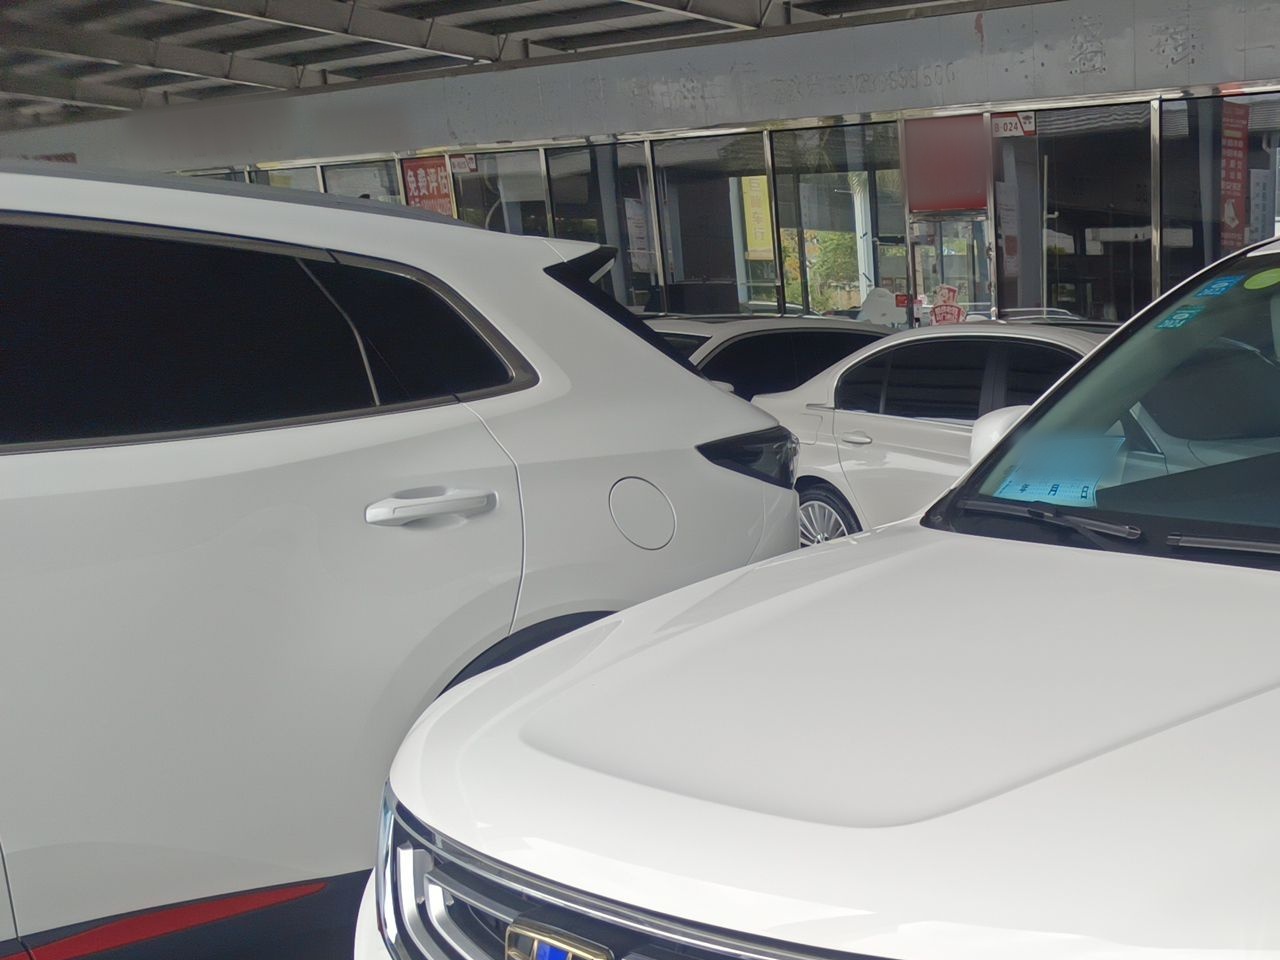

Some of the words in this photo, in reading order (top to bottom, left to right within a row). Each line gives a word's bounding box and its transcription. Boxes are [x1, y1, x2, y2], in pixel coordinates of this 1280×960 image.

[994, 121, 1019, 133] B-024
[406, 166, 449, 196] 免费评估
